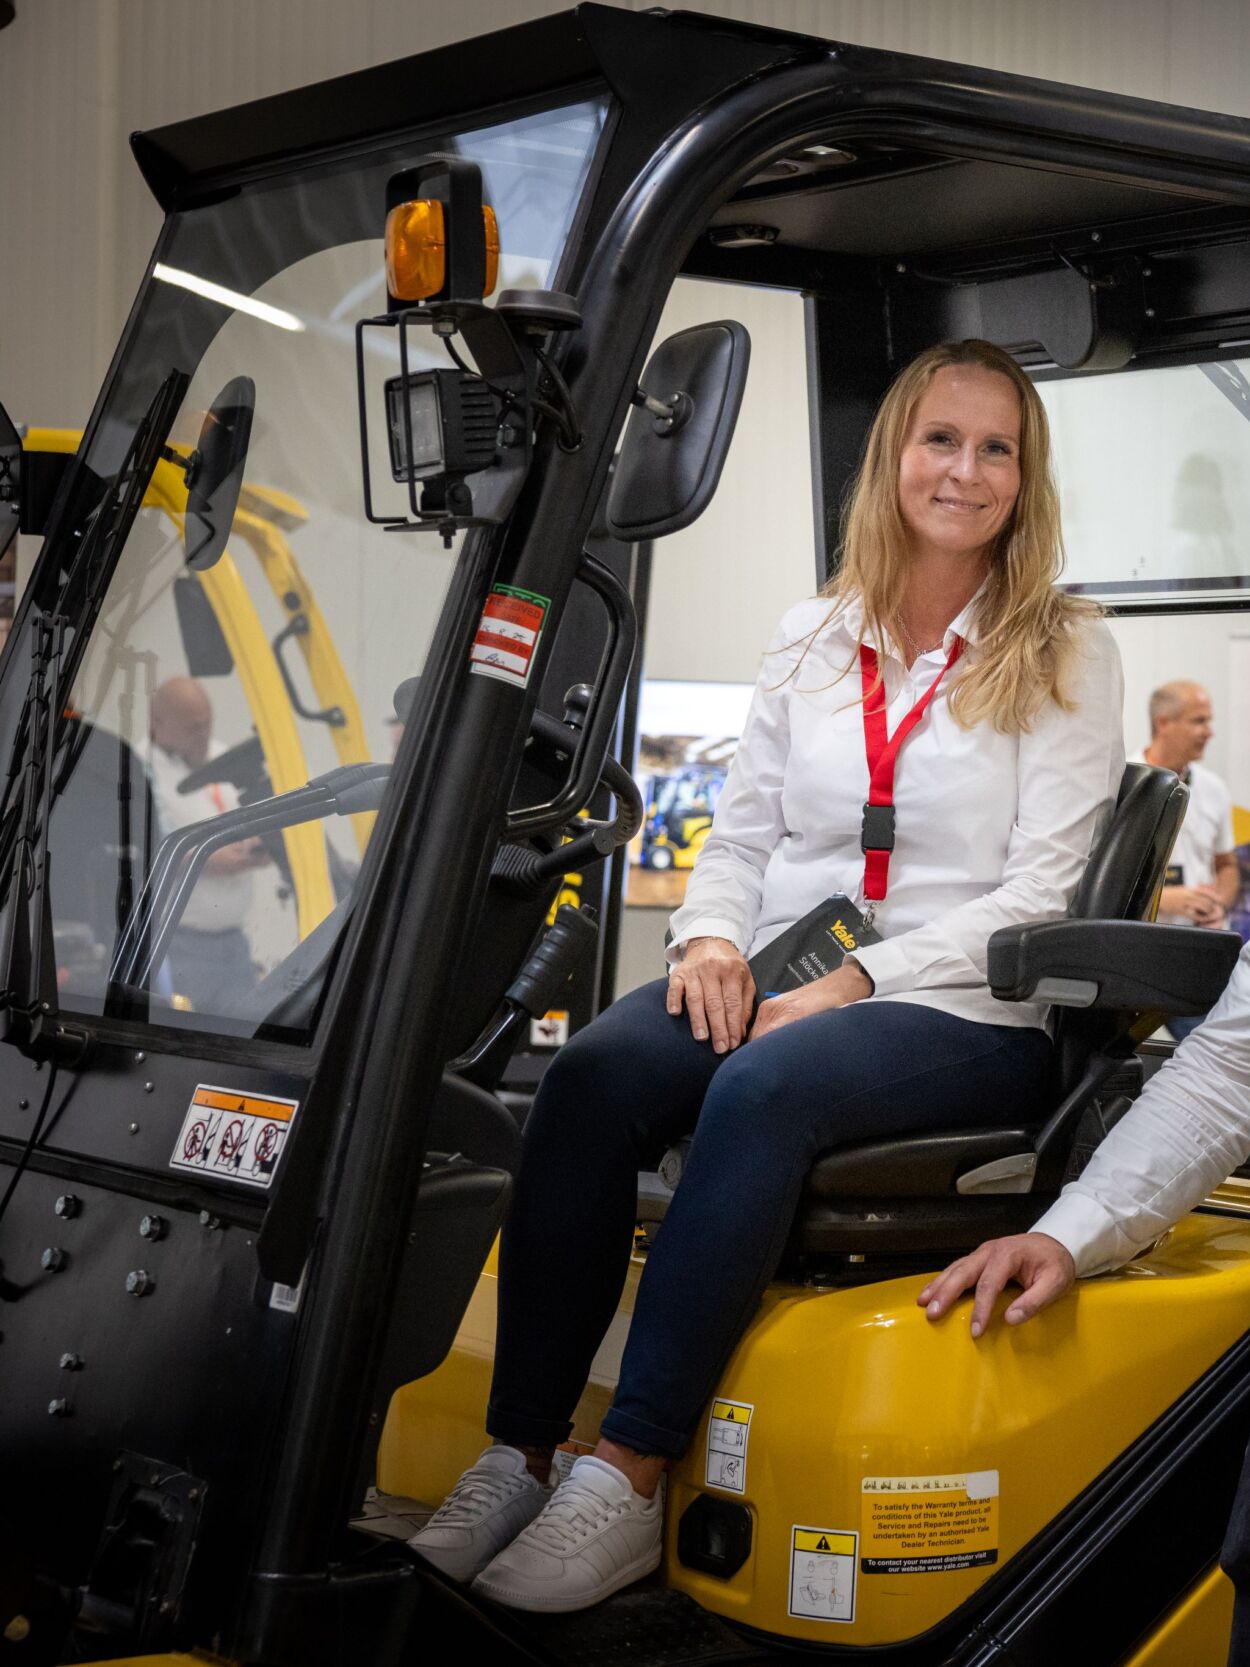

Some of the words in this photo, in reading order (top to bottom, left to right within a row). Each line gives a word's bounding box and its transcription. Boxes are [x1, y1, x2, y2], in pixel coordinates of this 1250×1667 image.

[830, 919, 856, 949] Yale
[808, 952, 829, 975] Annika
[873, 1503, 882, 1511] To
[884, 1503, 909, 1511] satisfy
[877, 1522, 905, 1530] Service
[924, 1521, 950, 1529] Repairs
[953, 1518, 969, 1526] need
[873, 1532, 915, 1540] undertaken
[939, 1528, 975, 1537] authorised
[943, 1554, 974, 1563] distributor
[927, 1561, 970, 1571] www.yale.com
